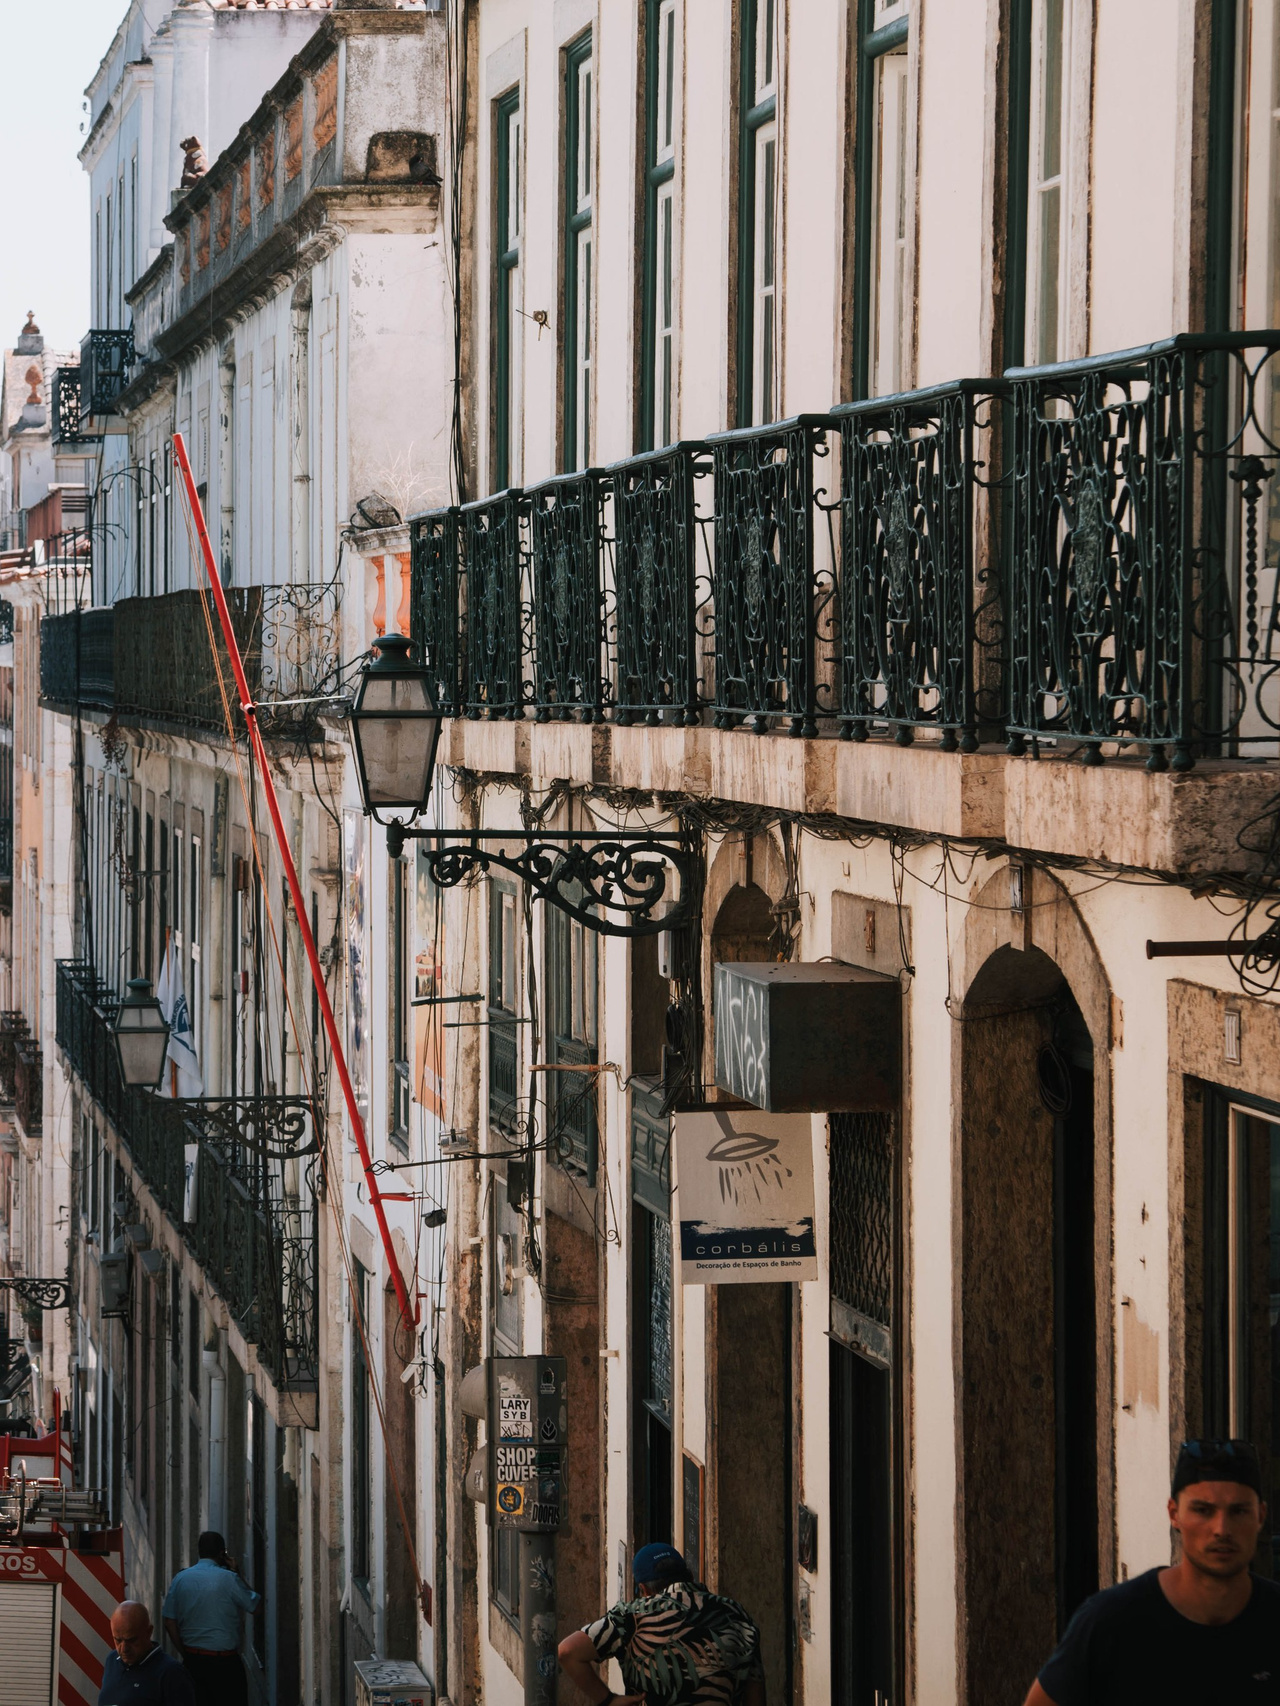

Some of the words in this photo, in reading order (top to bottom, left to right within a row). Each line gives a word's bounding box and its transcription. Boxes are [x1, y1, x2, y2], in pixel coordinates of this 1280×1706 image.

[695, 1241, 801, 1255] corbális
[696, 1261, 731, 1270] Decoração
[742, 1261, 769, 1269] Espaços
[770, 1260, 779, 1268] de
[501, 1399, 529, 1410] LARY
[497, 1447, 536, 1466] SHOP
[532, 1503, 560, 1525] DOOFUS
